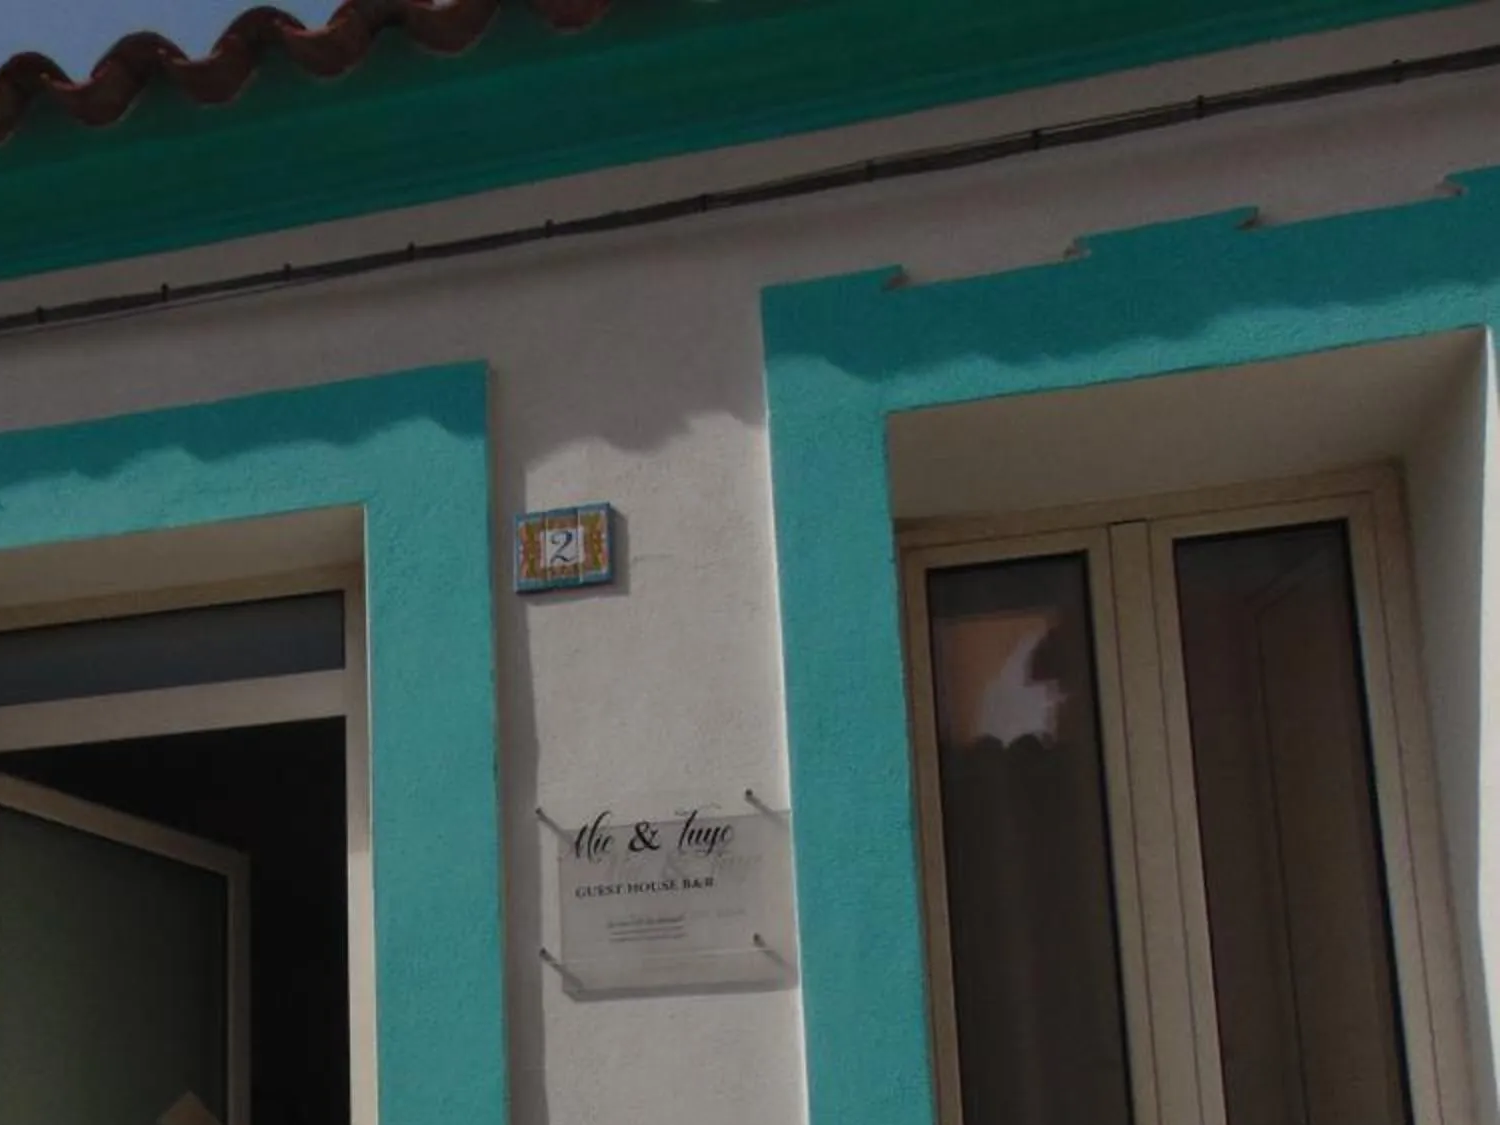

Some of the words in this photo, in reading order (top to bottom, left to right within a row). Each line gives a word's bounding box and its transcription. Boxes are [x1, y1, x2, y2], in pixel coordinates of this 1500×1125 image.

[550, 530, 578, 564] 2
[628, 820, 661, 852] &
[575, 882, 622, 899] GUEST
[627, 879, 677, 894] HOUSE
